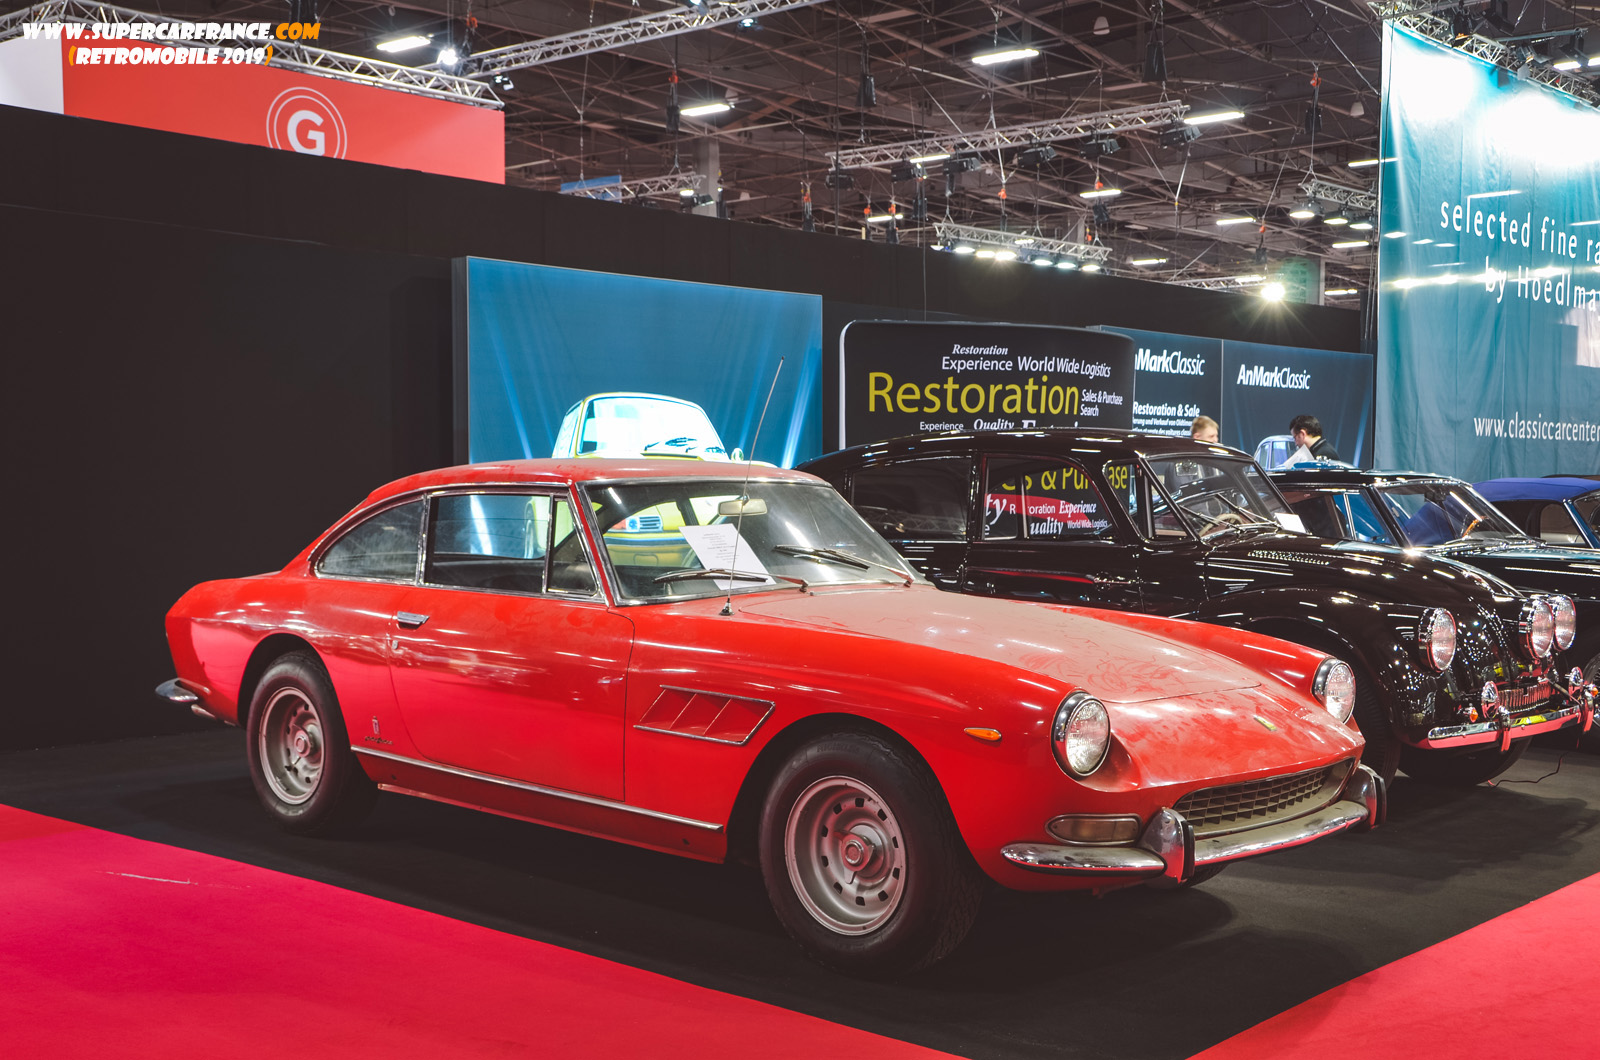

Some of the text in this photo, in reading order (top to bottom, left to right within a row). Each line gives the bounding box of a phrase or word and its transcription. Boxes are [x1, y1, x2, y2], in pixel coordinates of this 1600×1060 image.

[286, 109, 326, 157] G
[1440, 195, 1531, 248] selected
[1540, 215, 1578, 259] fine
[1485, 255, 1507, 304] by
[951, 343, 1009, 355] Restoration
[941, 355, 1112, 379] Experience World Wide Logistics
[1236, 363, 1311, 389] AnMarkClassic
[868, 371, 1080, 415] Restoration
[1081, 388, 1124, 406] Sales & Purchase
[1079, 403, 1100, 417] Search
[1133, 402, 1200, 417] Restoration & Sale
[919, 421, 964, 431] Experience
[973, 418, 1015, 430] Quality
[1059, 500, 1097, 518] Experience
[1030, 517, 1108, 535] uality World Wide Logistics
